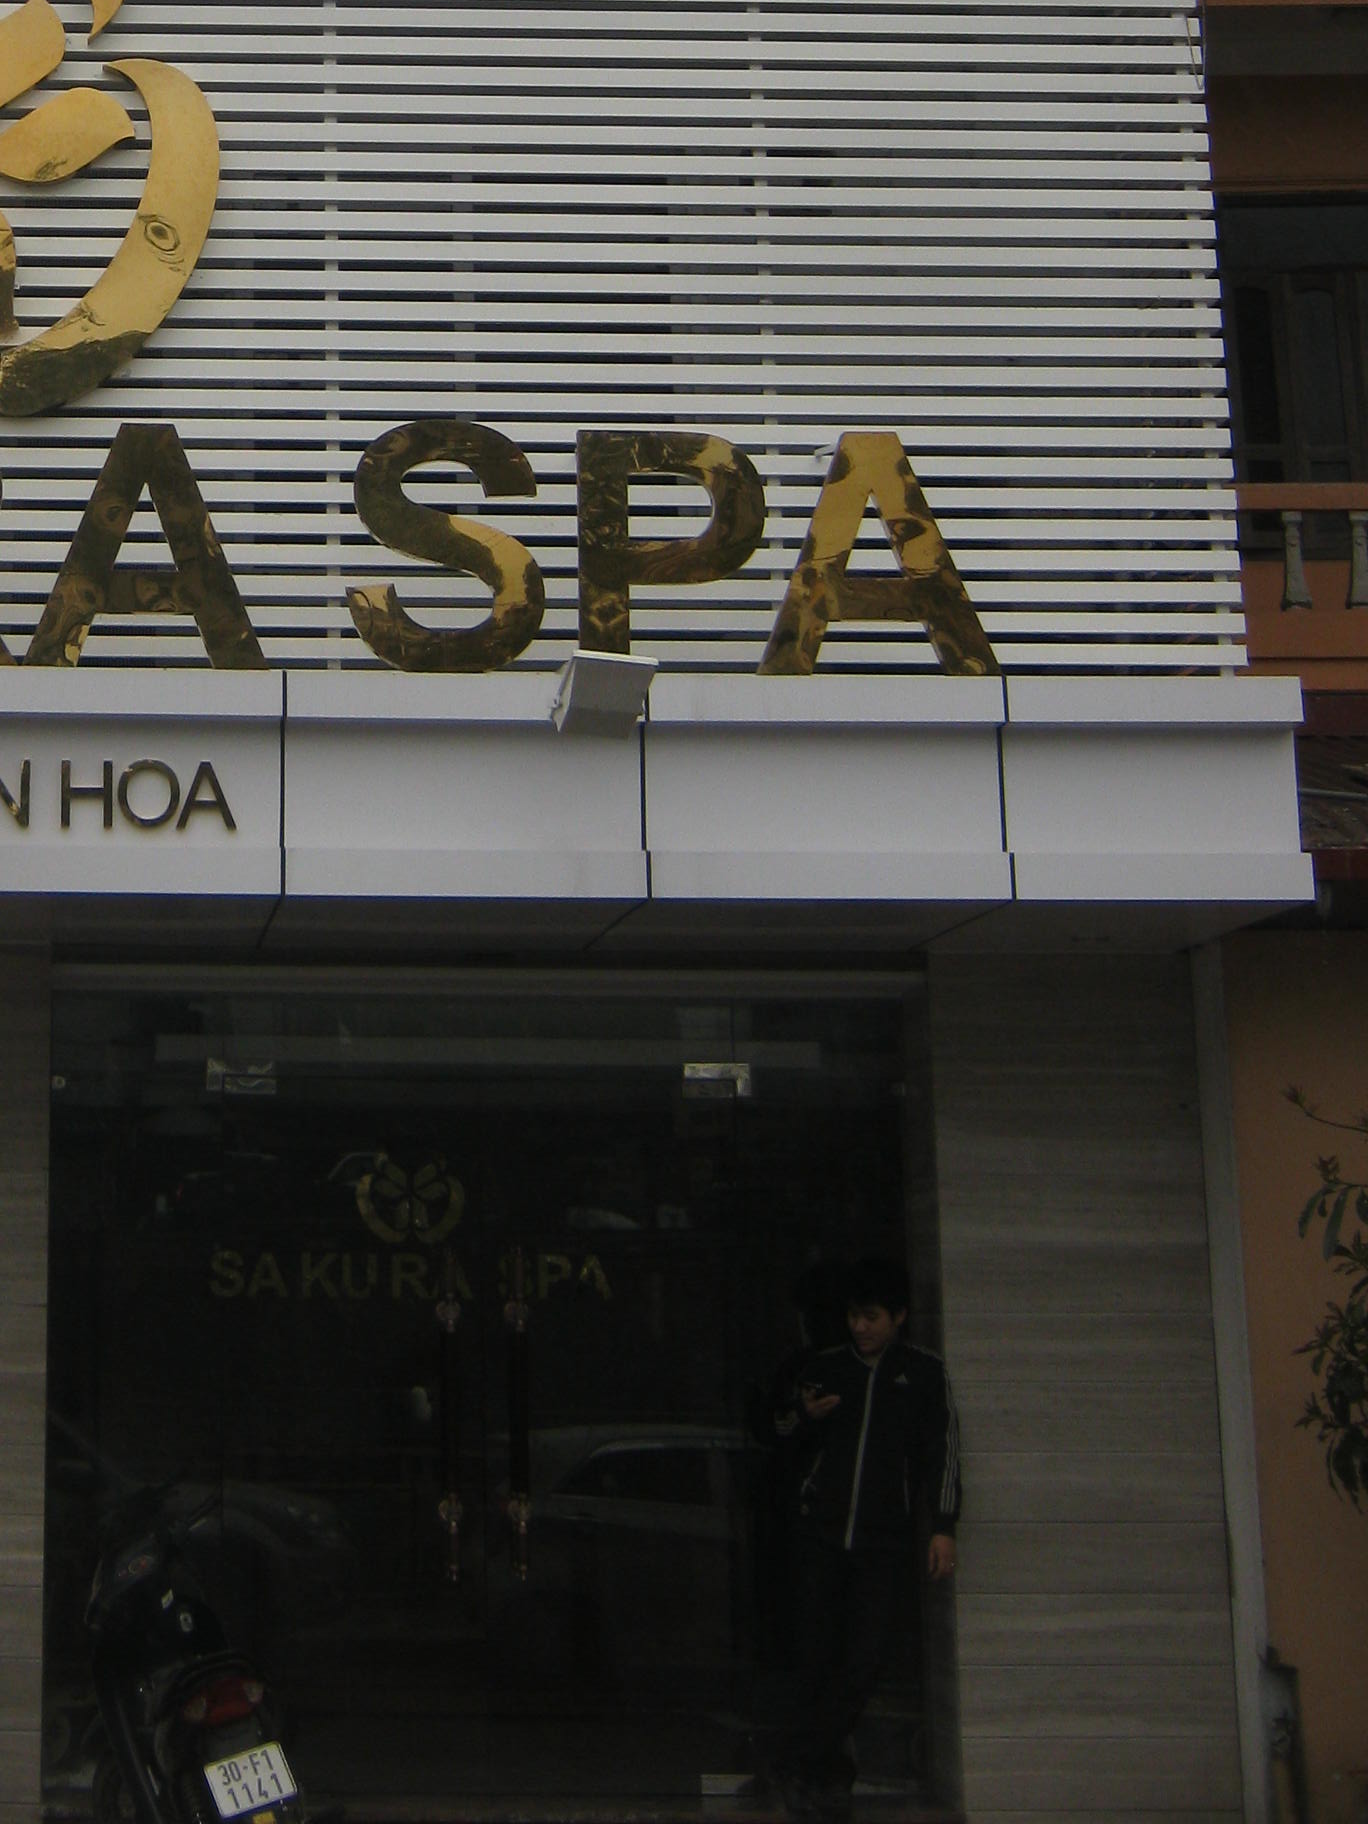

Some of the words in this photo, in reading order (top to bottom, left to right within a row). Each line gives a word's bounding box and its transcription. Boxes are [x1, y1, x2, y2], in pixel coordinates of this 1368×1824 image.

[346, 419, 1002, 676] SPA
[60, 758, 238, 831] HOA
[208, 1249, 473, 1300] SAKURA
[217, 1749, 273, 1786] 30-F1
[228, 1773, 283, 1809] 1141
